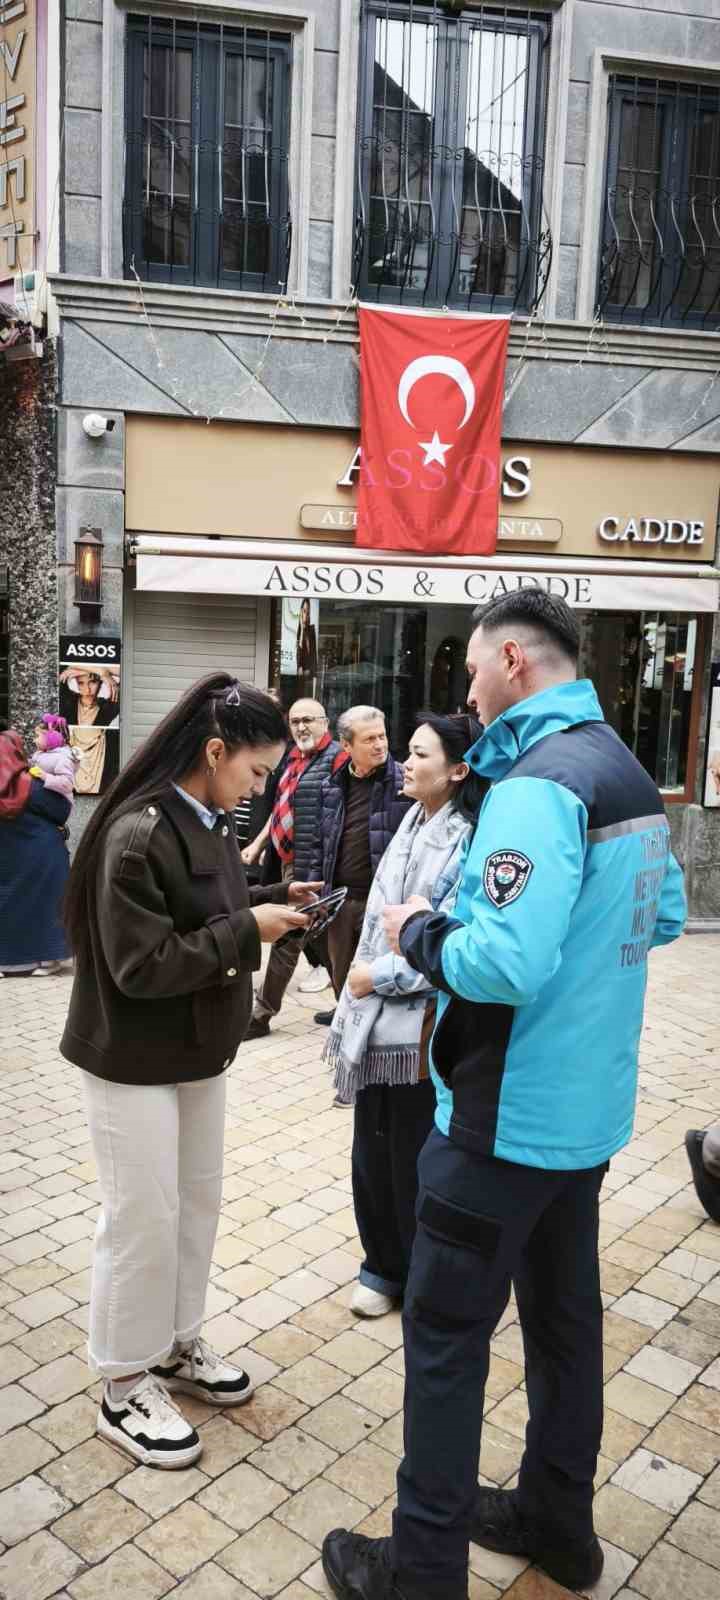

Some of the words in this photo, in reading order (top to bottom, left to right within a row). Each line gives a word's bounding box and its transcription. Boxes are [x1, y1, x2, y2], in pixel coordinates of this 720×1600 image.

[598, 516, 705, 545] CADDE
[264, 564, 385, 596] ASSOS
[412, 570, 437, 598] &
[66, 643, 117, 659] ASSOS
